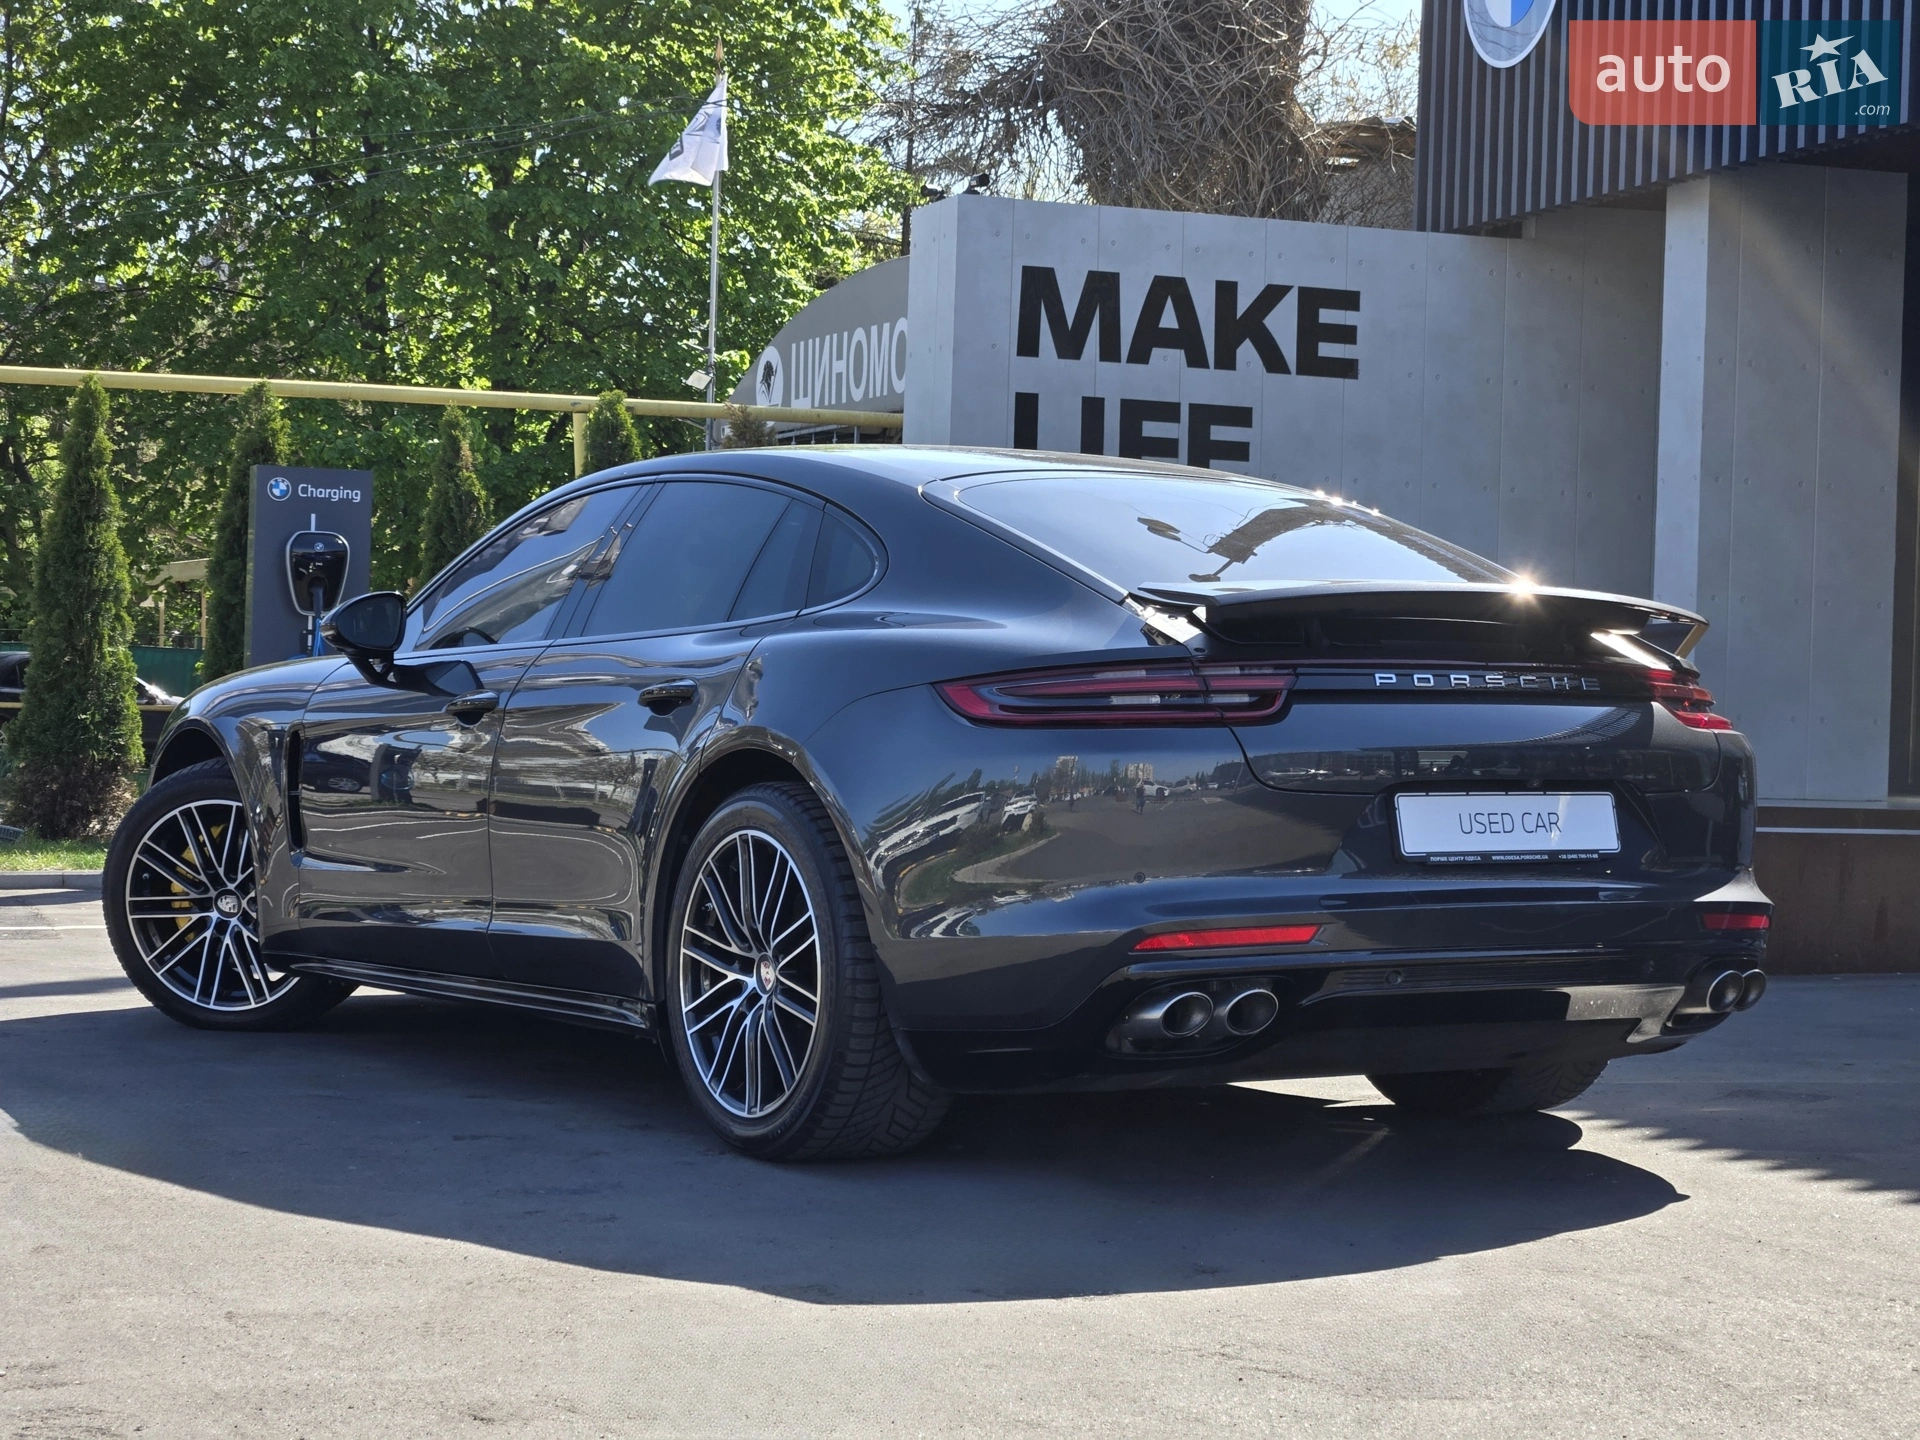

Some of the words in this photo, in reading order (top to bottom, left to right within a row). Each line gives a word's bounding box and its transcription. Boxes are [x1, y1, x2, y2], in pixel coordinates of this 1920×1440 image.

[1016, 265, 1361, 380] MAKE
[298, 484, 361, 503] Charging
[1374, 672, 1601, 691] PORSCHE
[1458, 812, 1515, 834] USED
[1521, 812, 1562, 833] CAR
